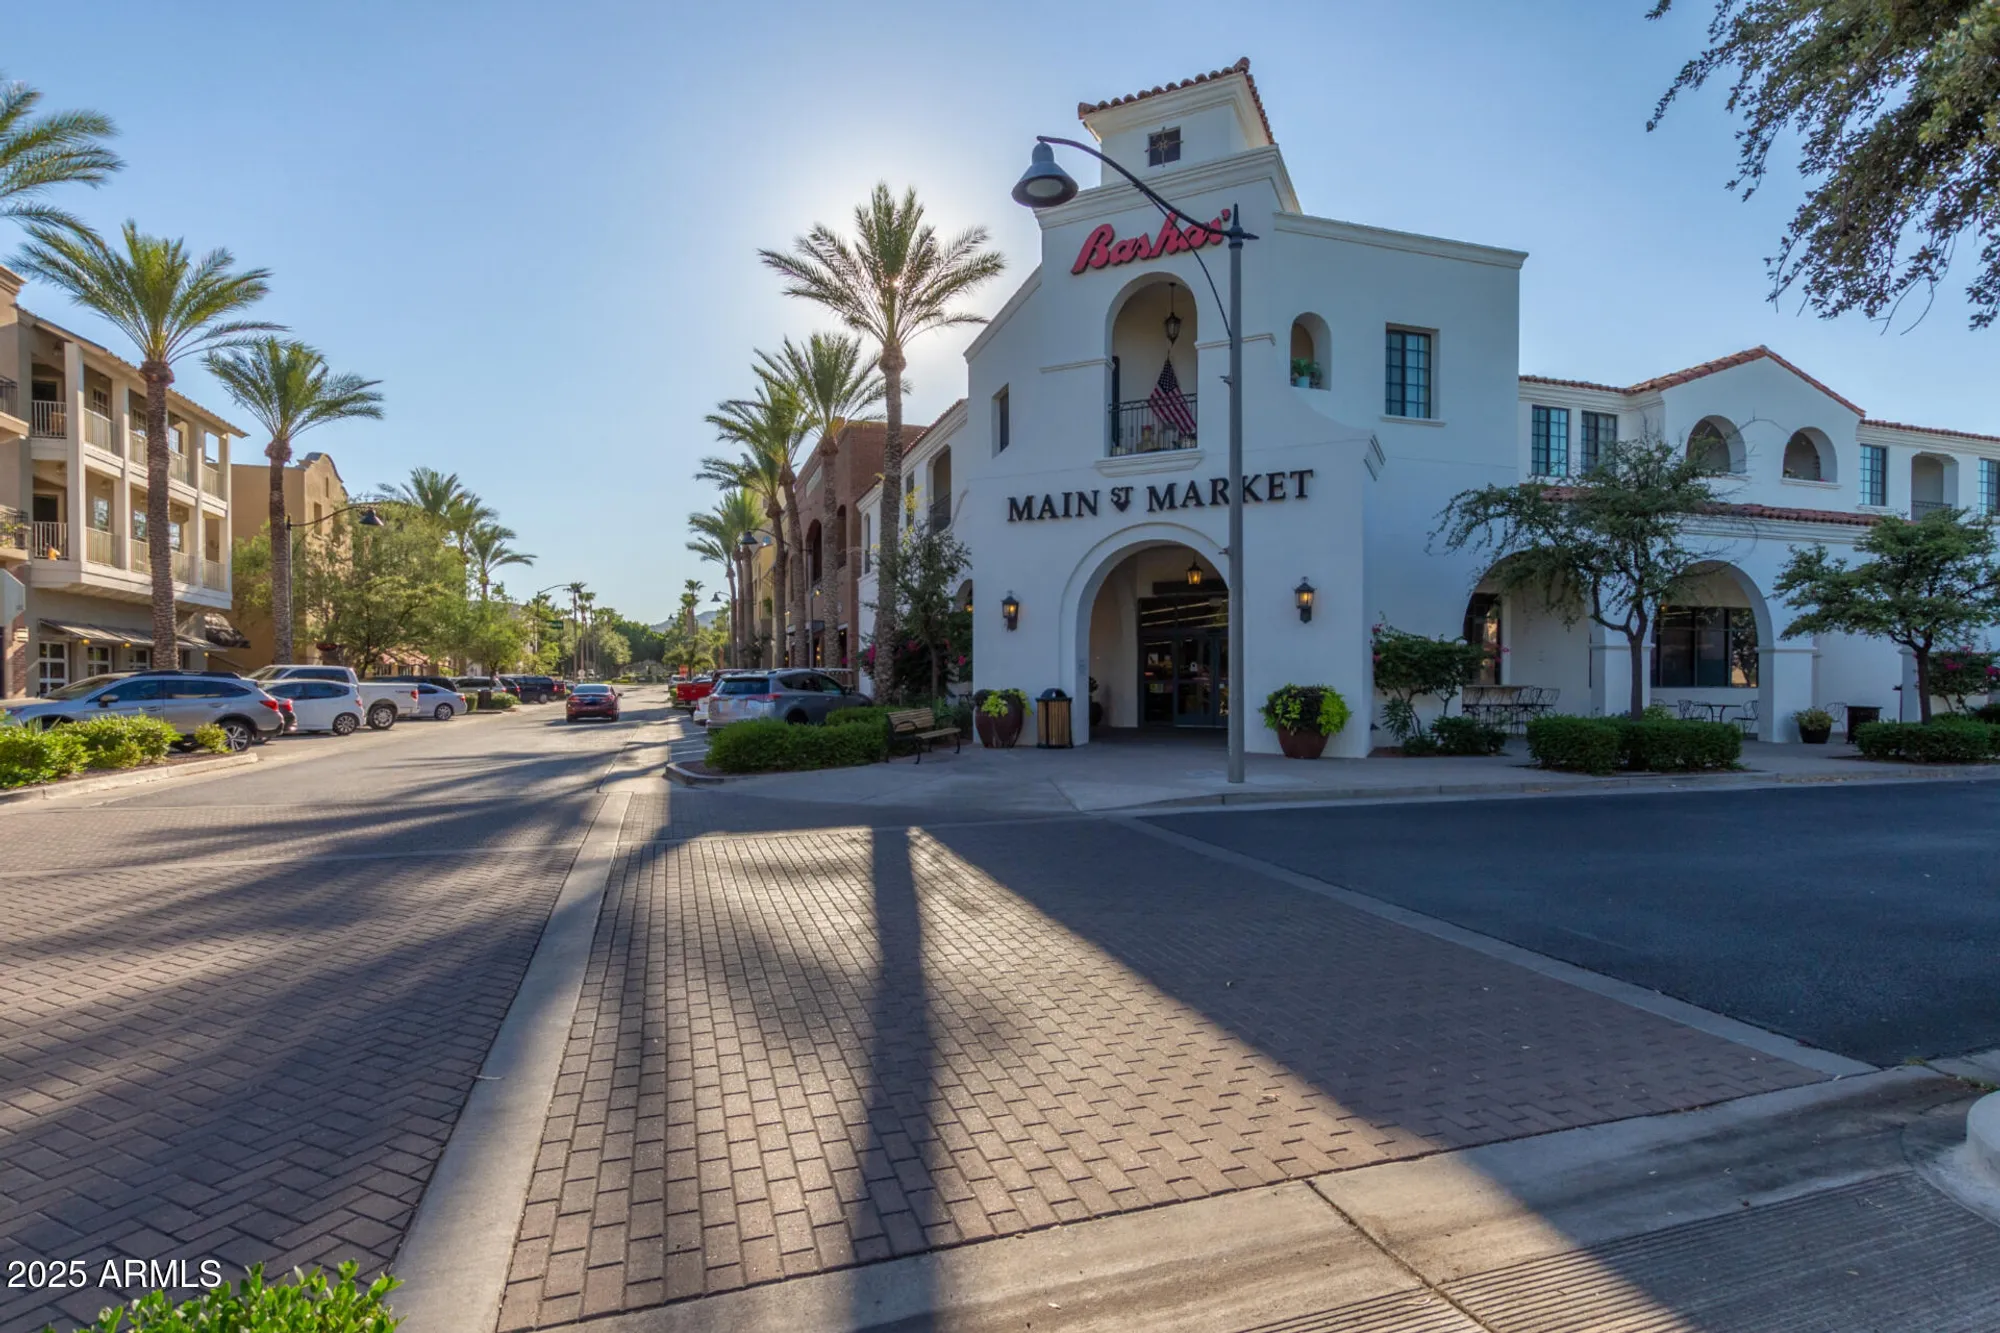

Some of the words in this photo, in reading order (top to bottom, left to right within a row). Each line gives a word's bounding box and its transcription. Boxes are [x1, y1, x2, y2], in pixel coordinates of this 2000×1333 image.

[1071, 208, 1231, 275] Bashas'
[1007, 489, 1099, 521] MAIN
[1110, 486, 1134, 505] ST
[1146, 469, 1313, 512] MARKET
